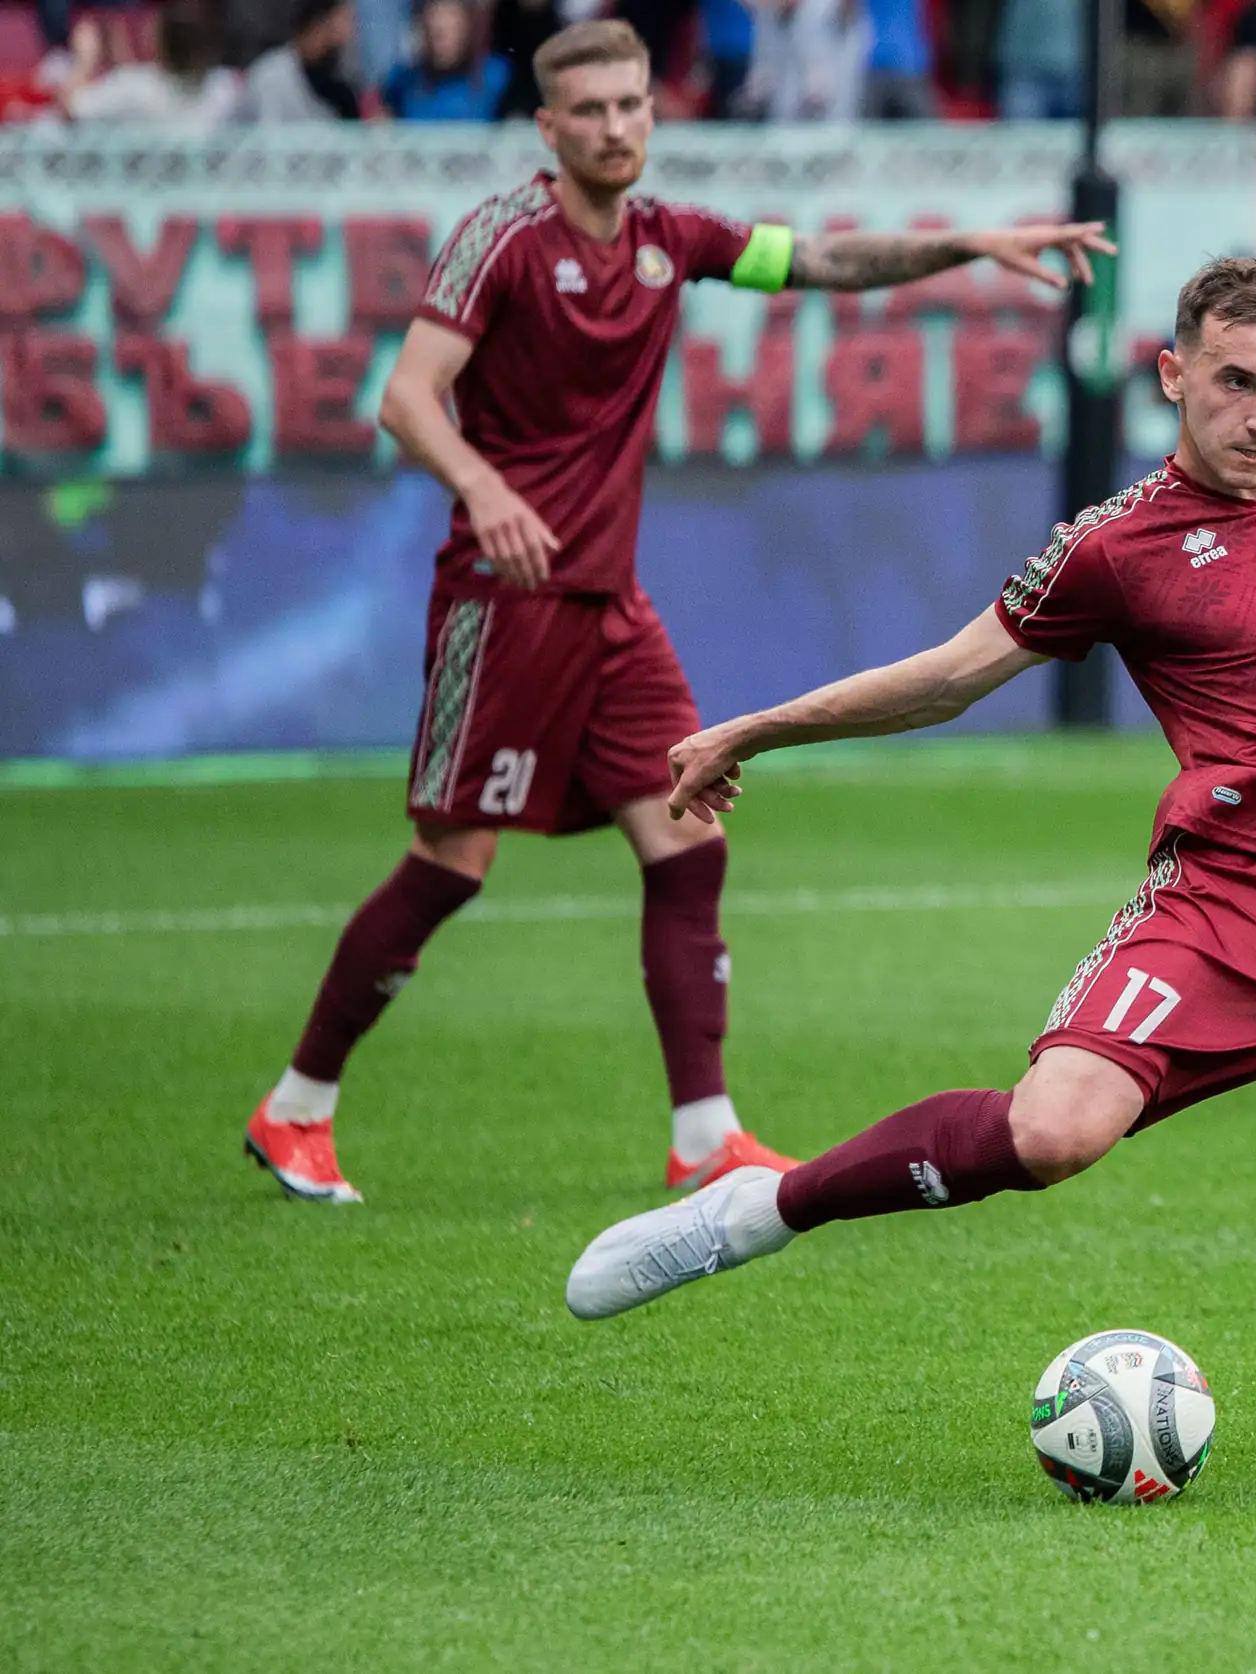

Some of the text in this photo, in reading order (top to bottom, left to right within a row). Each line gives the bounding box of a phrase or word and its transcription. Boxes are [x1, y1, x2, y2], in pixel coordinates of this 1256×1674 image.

[1190, 545, 1228, 569] errea
[478, 748, 537, 816] 20
[1102, 967, 1182, 1045] 17
